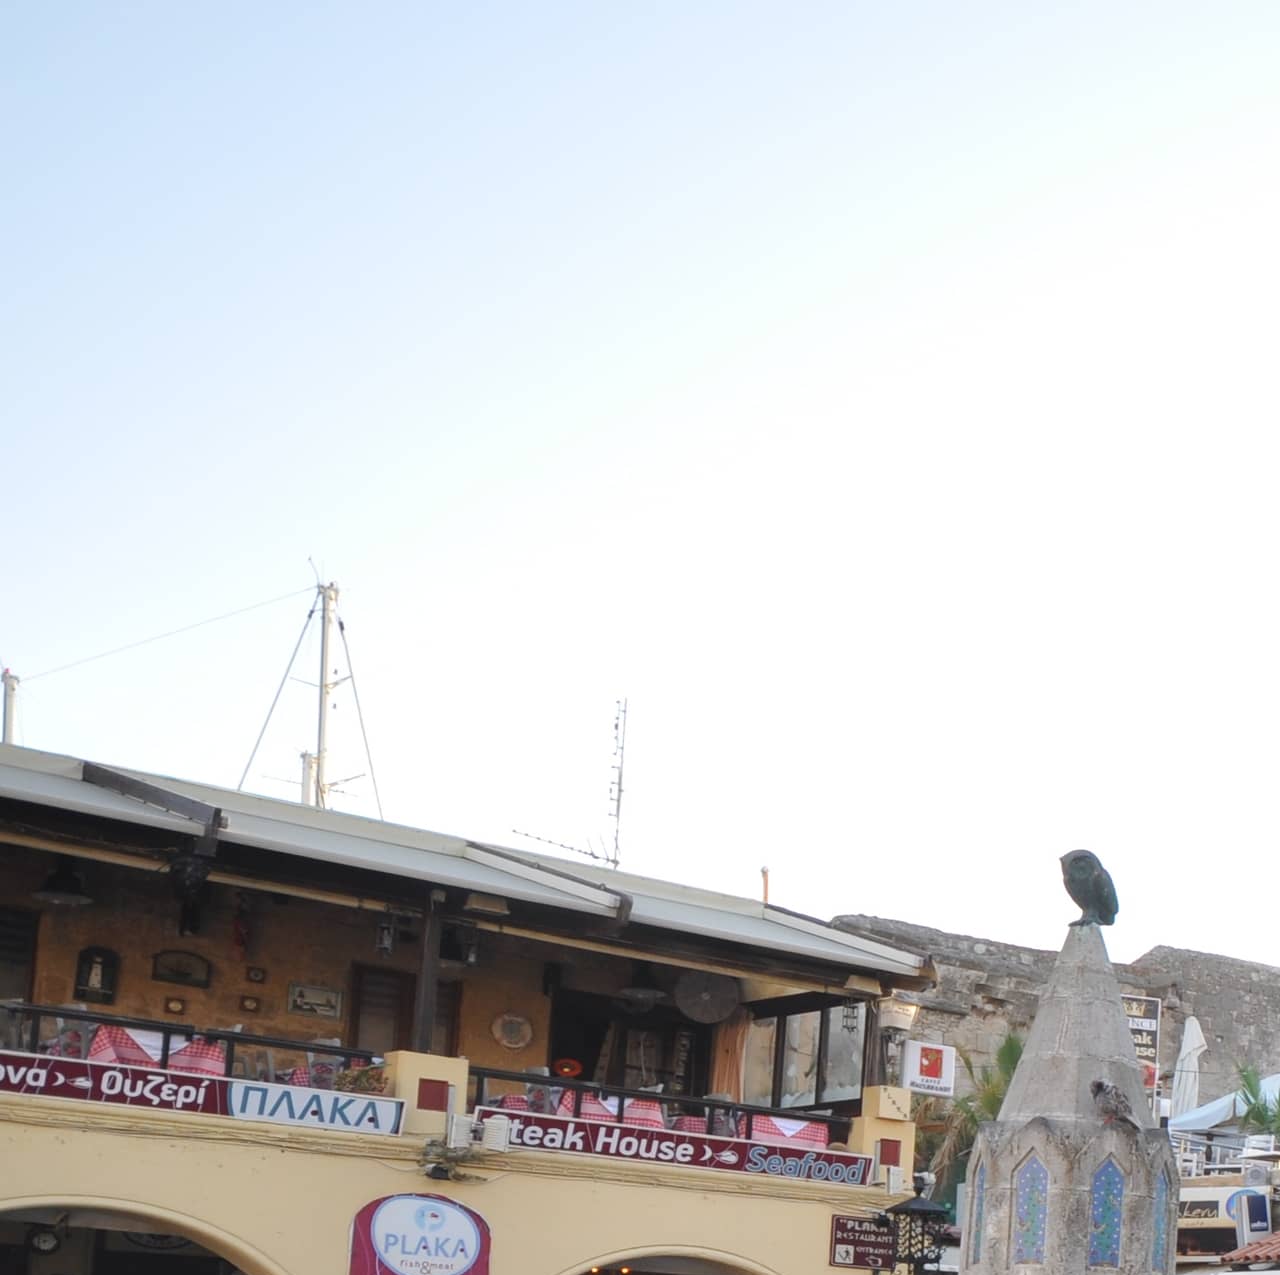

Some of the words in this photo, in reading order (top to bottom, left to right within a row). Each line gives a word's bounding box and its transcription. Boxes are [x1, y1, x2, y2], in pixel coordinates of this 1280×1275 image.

[1131, 1032, 1153, 1045] ak
[101, 1070, 208, 1109] Ουζερί
[240, 1085, 380, 1130] ΠΛΑΚΑ
[490, 1115, 585, 1151] teak
[595, 1127, 694, 1162] House
[746, 1146, 866, 1185] Seafood
[384, 1233, 469, 1259] PLAKA
[836, 1231, 893, 1243] RESTAURANT
